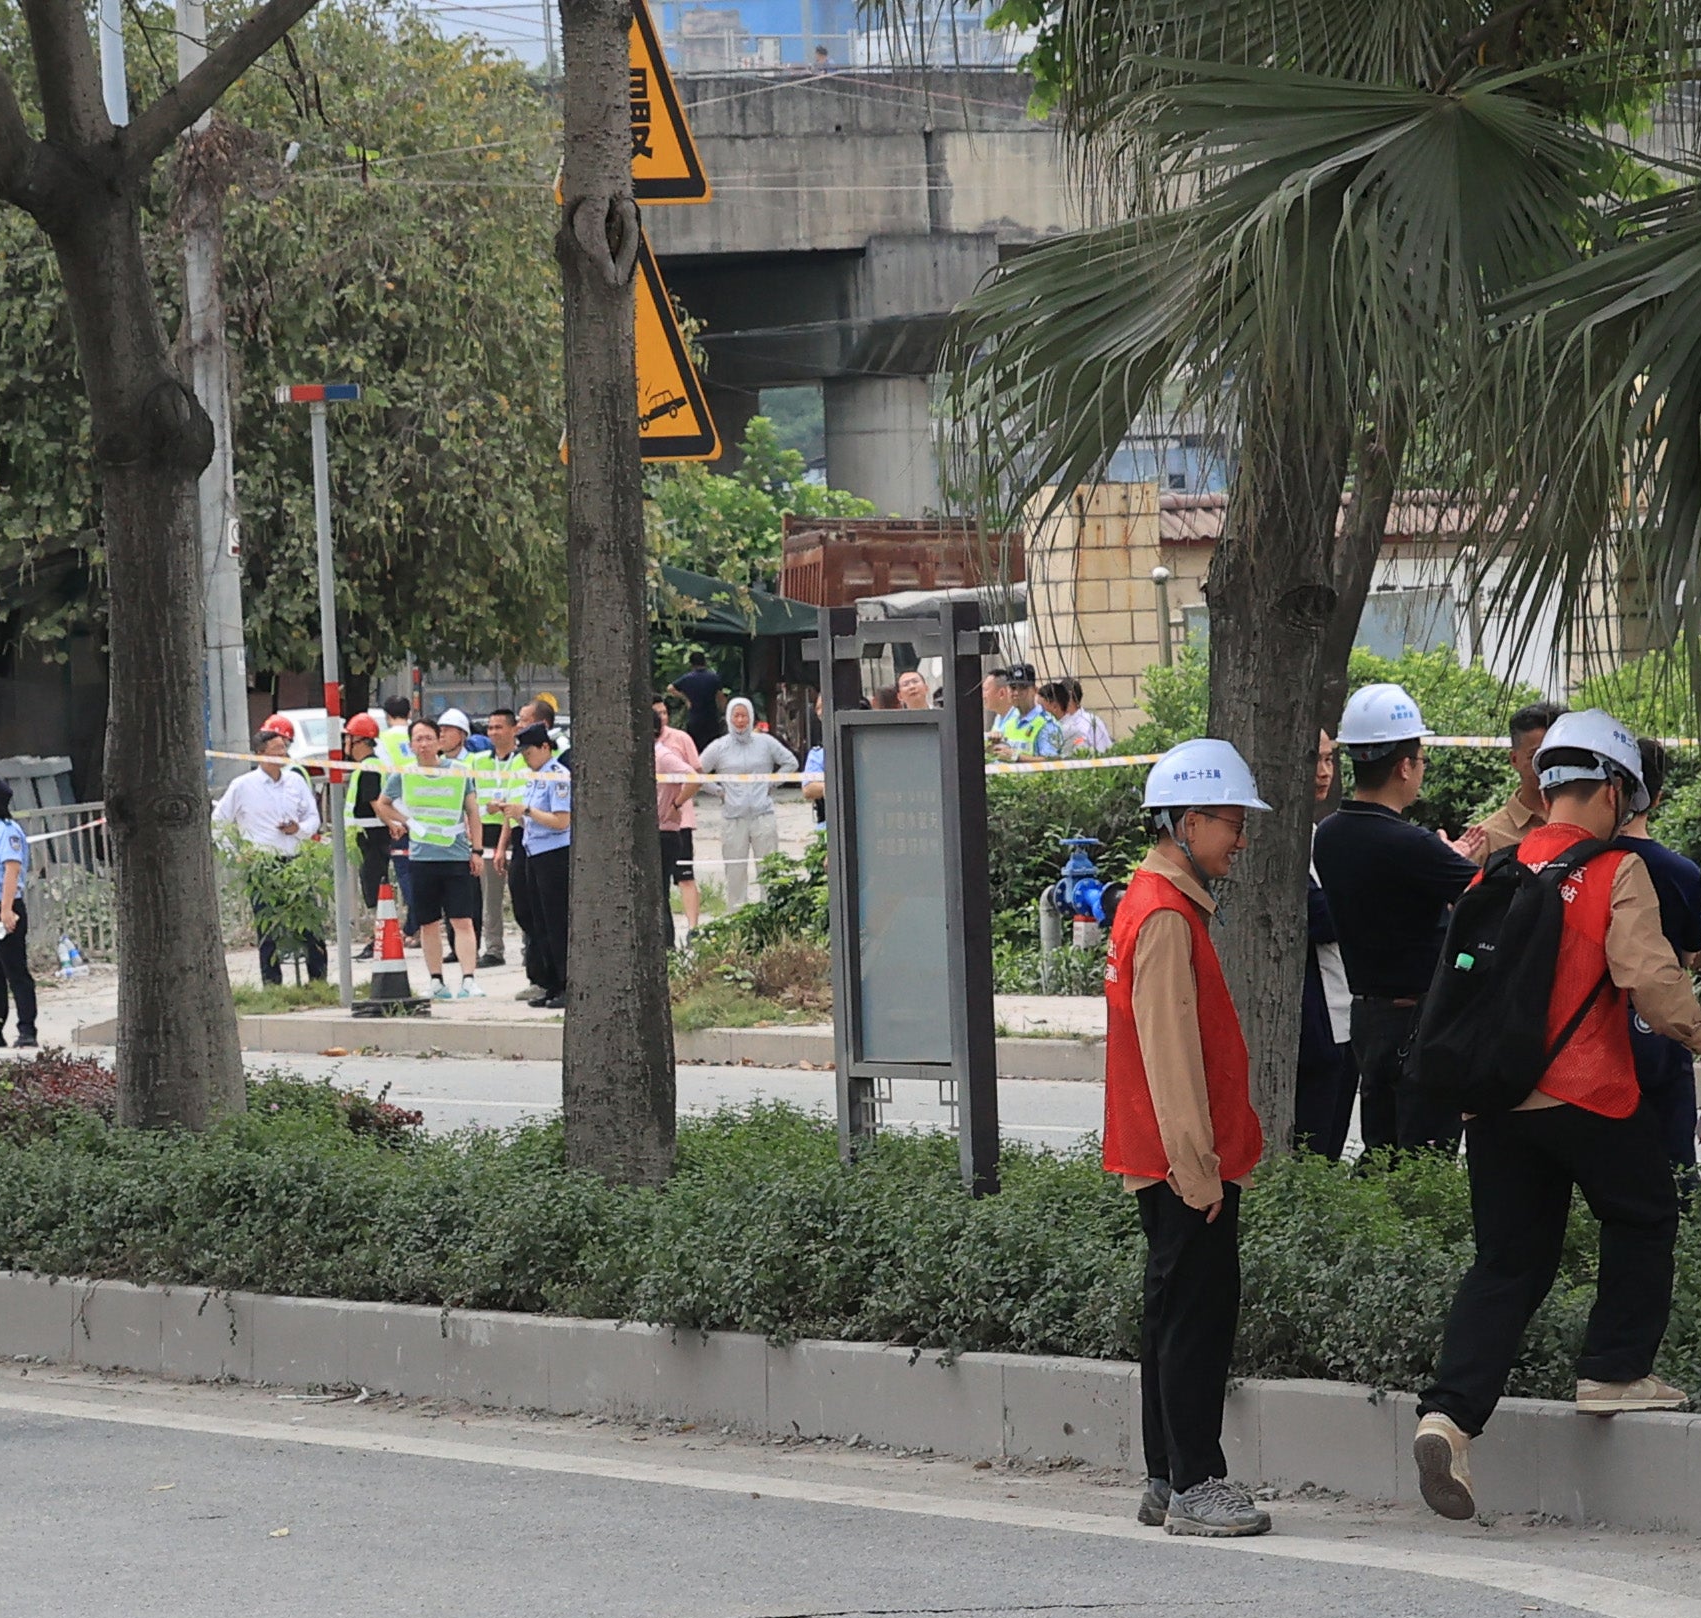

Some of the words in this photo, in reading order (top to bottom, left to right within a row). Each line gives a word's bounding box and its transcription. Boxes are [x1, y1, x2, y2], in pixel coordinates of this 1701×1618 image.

[1173, 769, 1222, 783] 中铁二十五局
